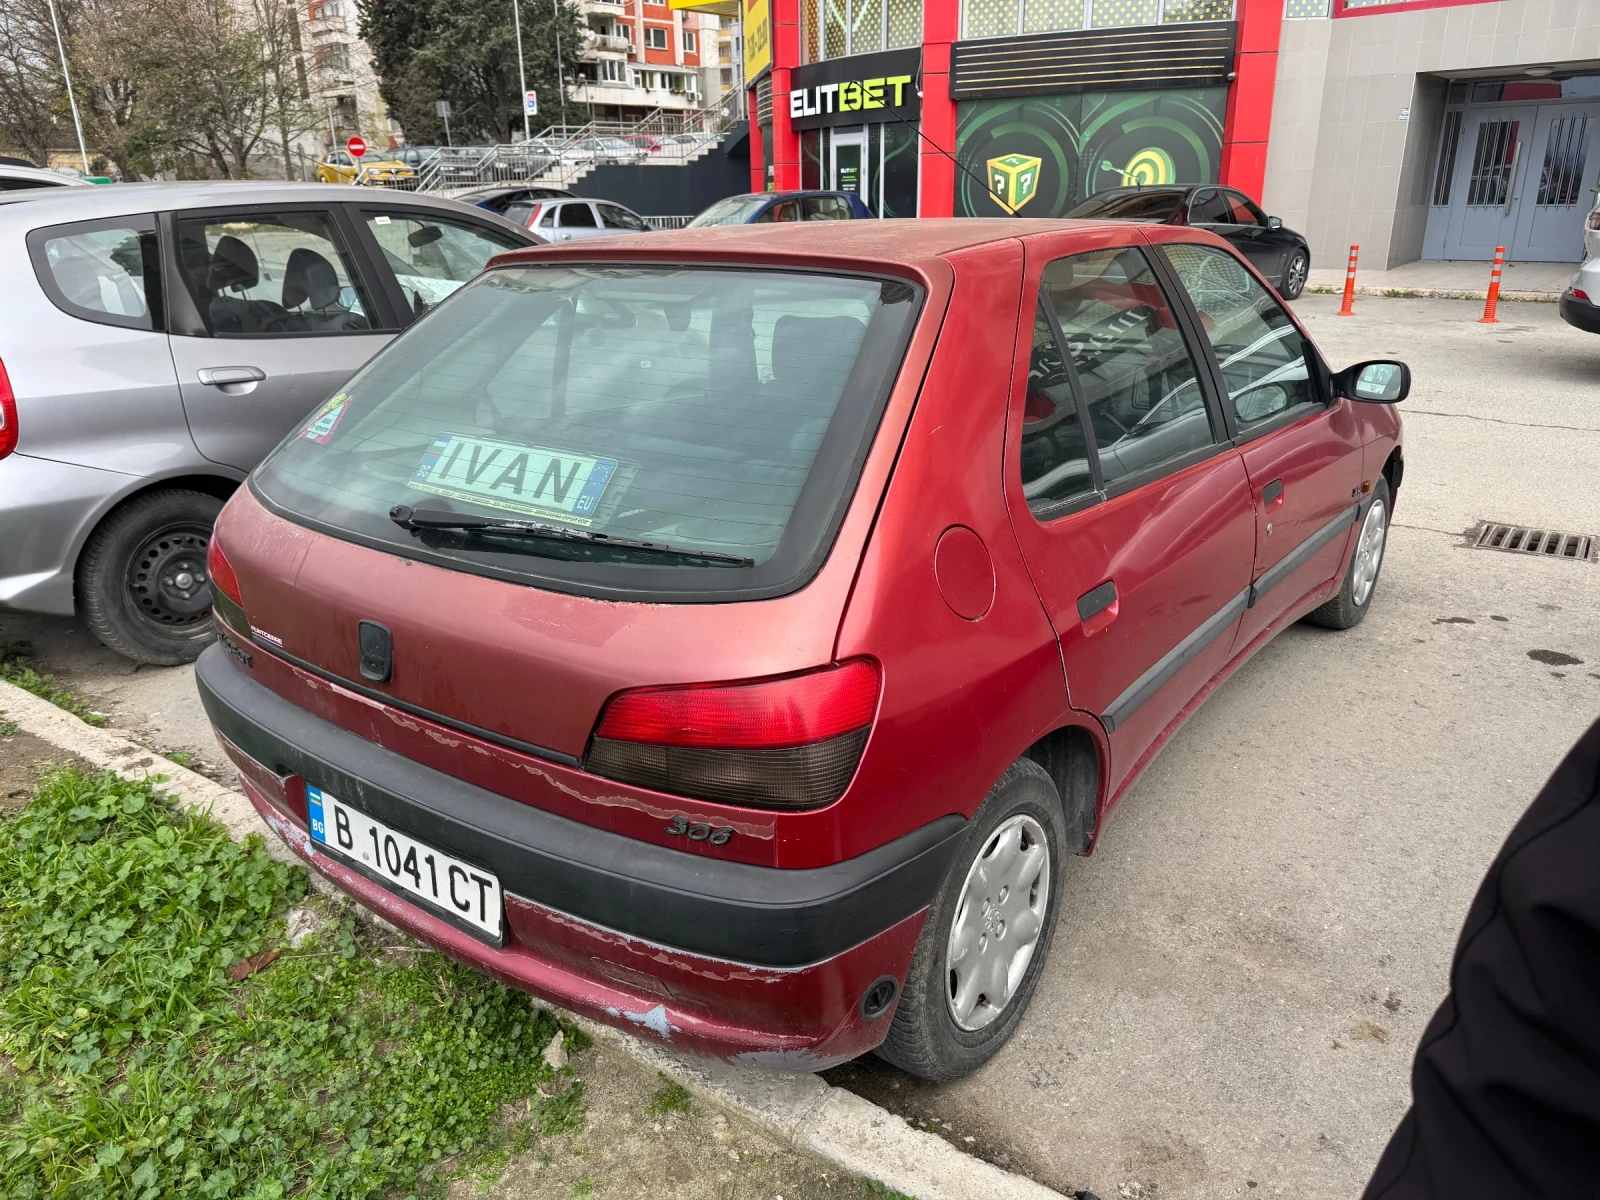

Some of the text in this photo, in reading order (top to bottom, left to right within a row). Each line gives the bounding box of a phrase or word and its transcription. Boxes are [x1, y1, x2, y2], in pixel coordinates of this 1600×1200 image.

[790, 75, 911, 118] ELITBET
[416, 465, 431, 478] BG
[438, 442, 582, 504] IVAN
[576, 495, 593, 510] EU
[312, 818, 324, 834] BG
[664, 815, 734, 846] 306
[369, 825, 438, 898] 1041
[448, 864, 493, 923] CT
